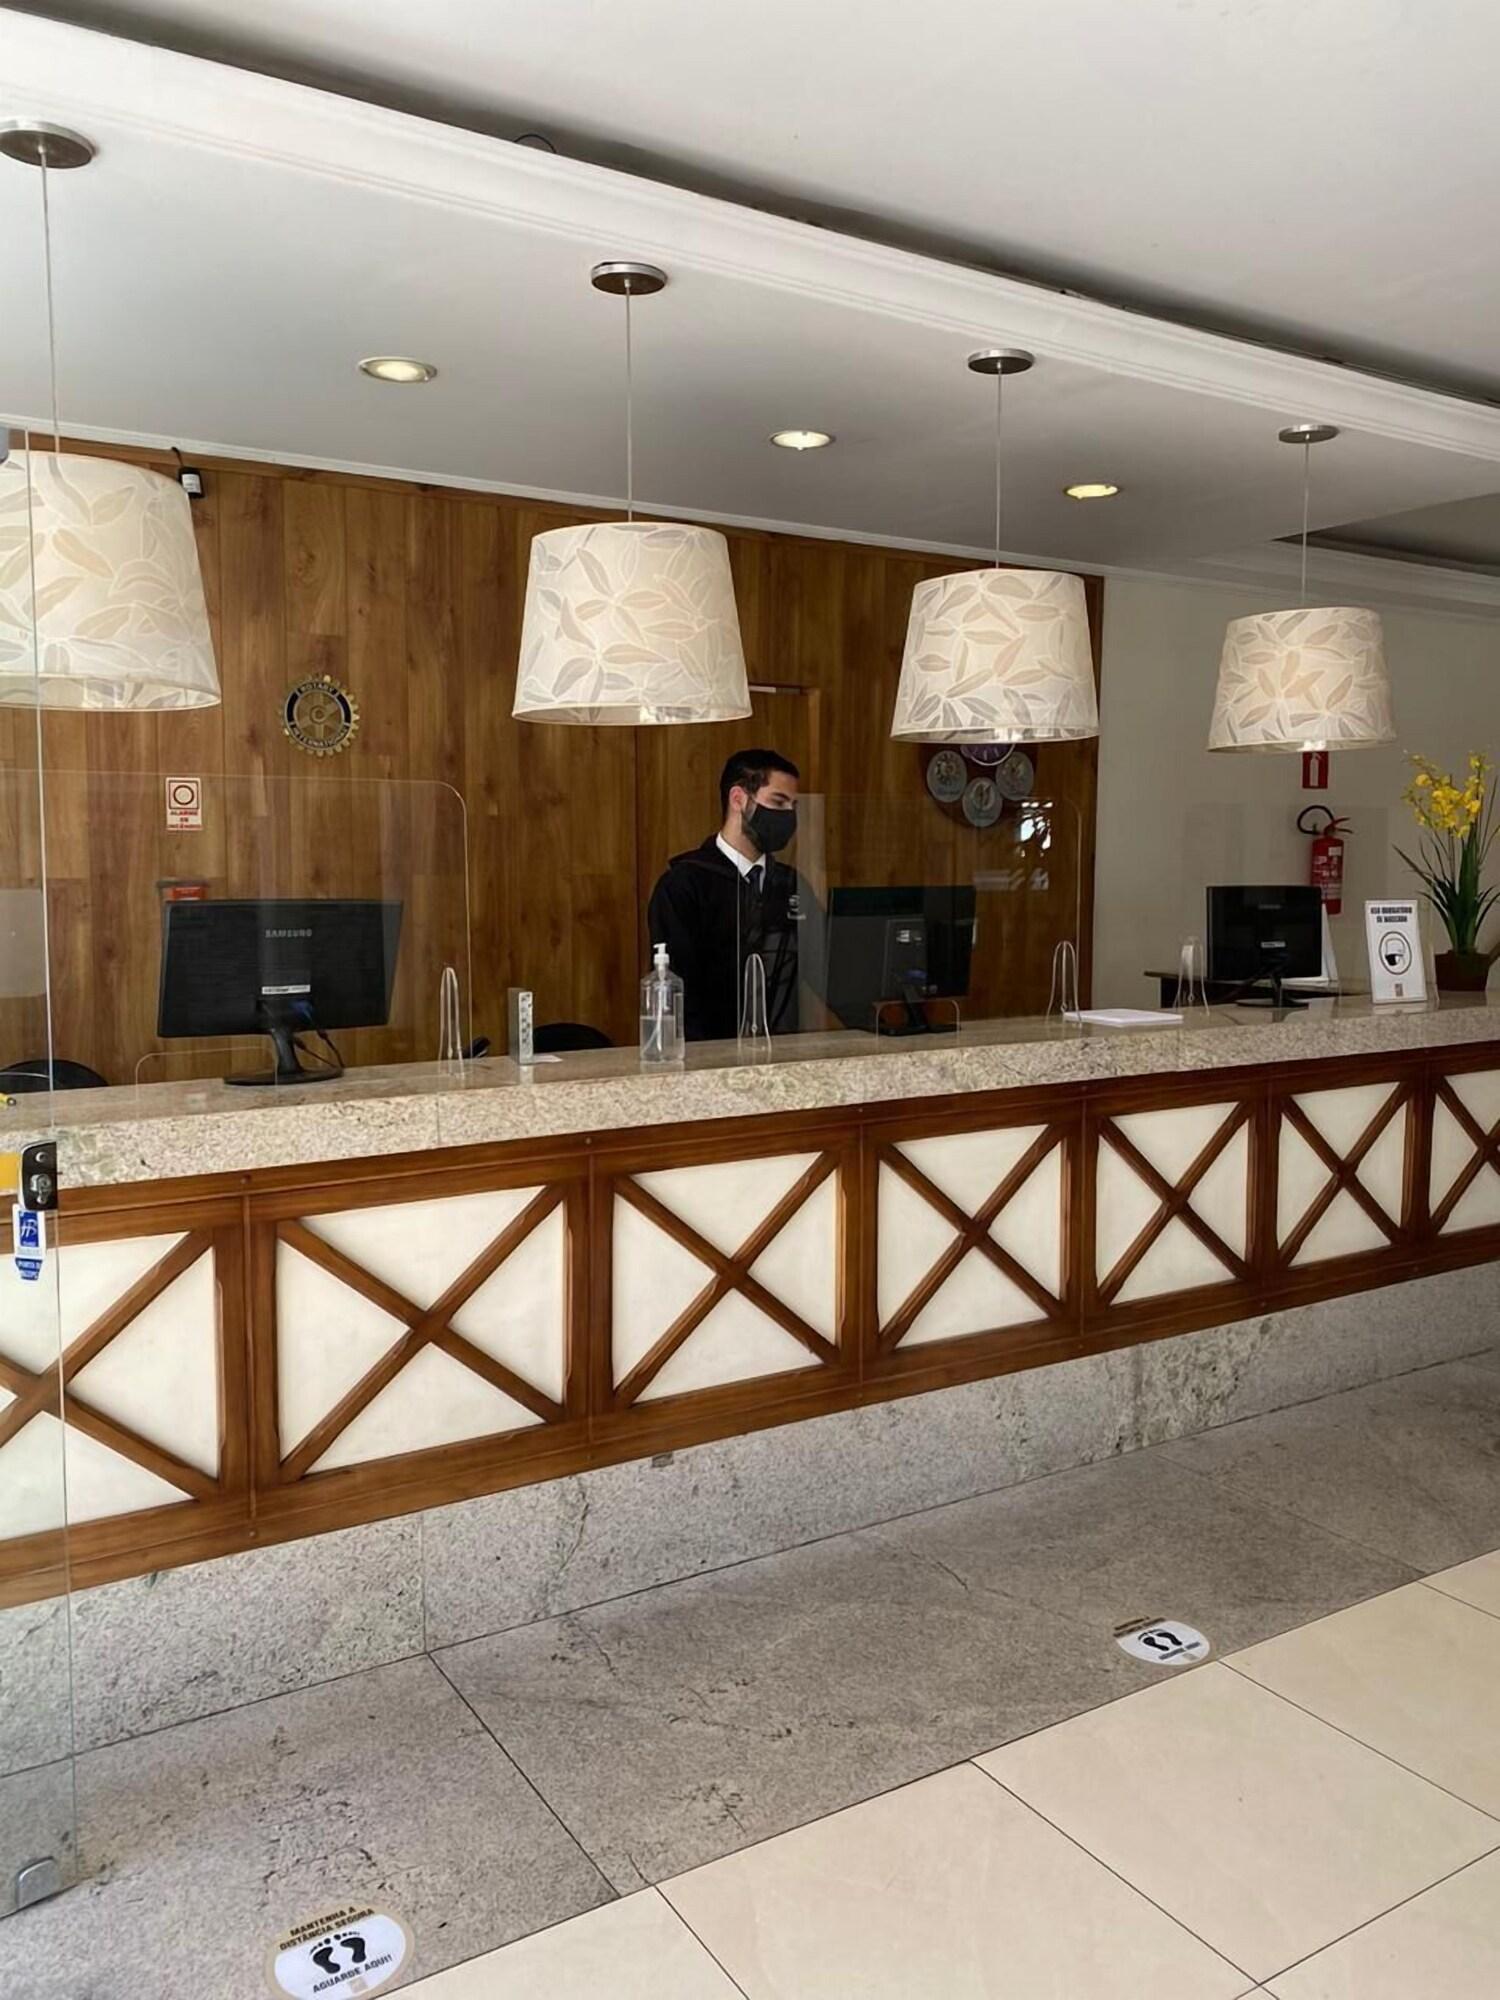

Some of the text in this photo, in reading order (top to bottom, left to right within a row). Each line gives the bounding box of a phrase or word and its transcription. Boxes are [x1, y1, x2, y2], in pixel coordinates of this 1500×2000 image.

[265, 928, 313, 938] SAMSUNG
[290, 1906, 357, 1936] MANTENHA A
[335, 1908, 375, 1928] SEGURA
[313, 1967, 362, 1993] AGUARDE
